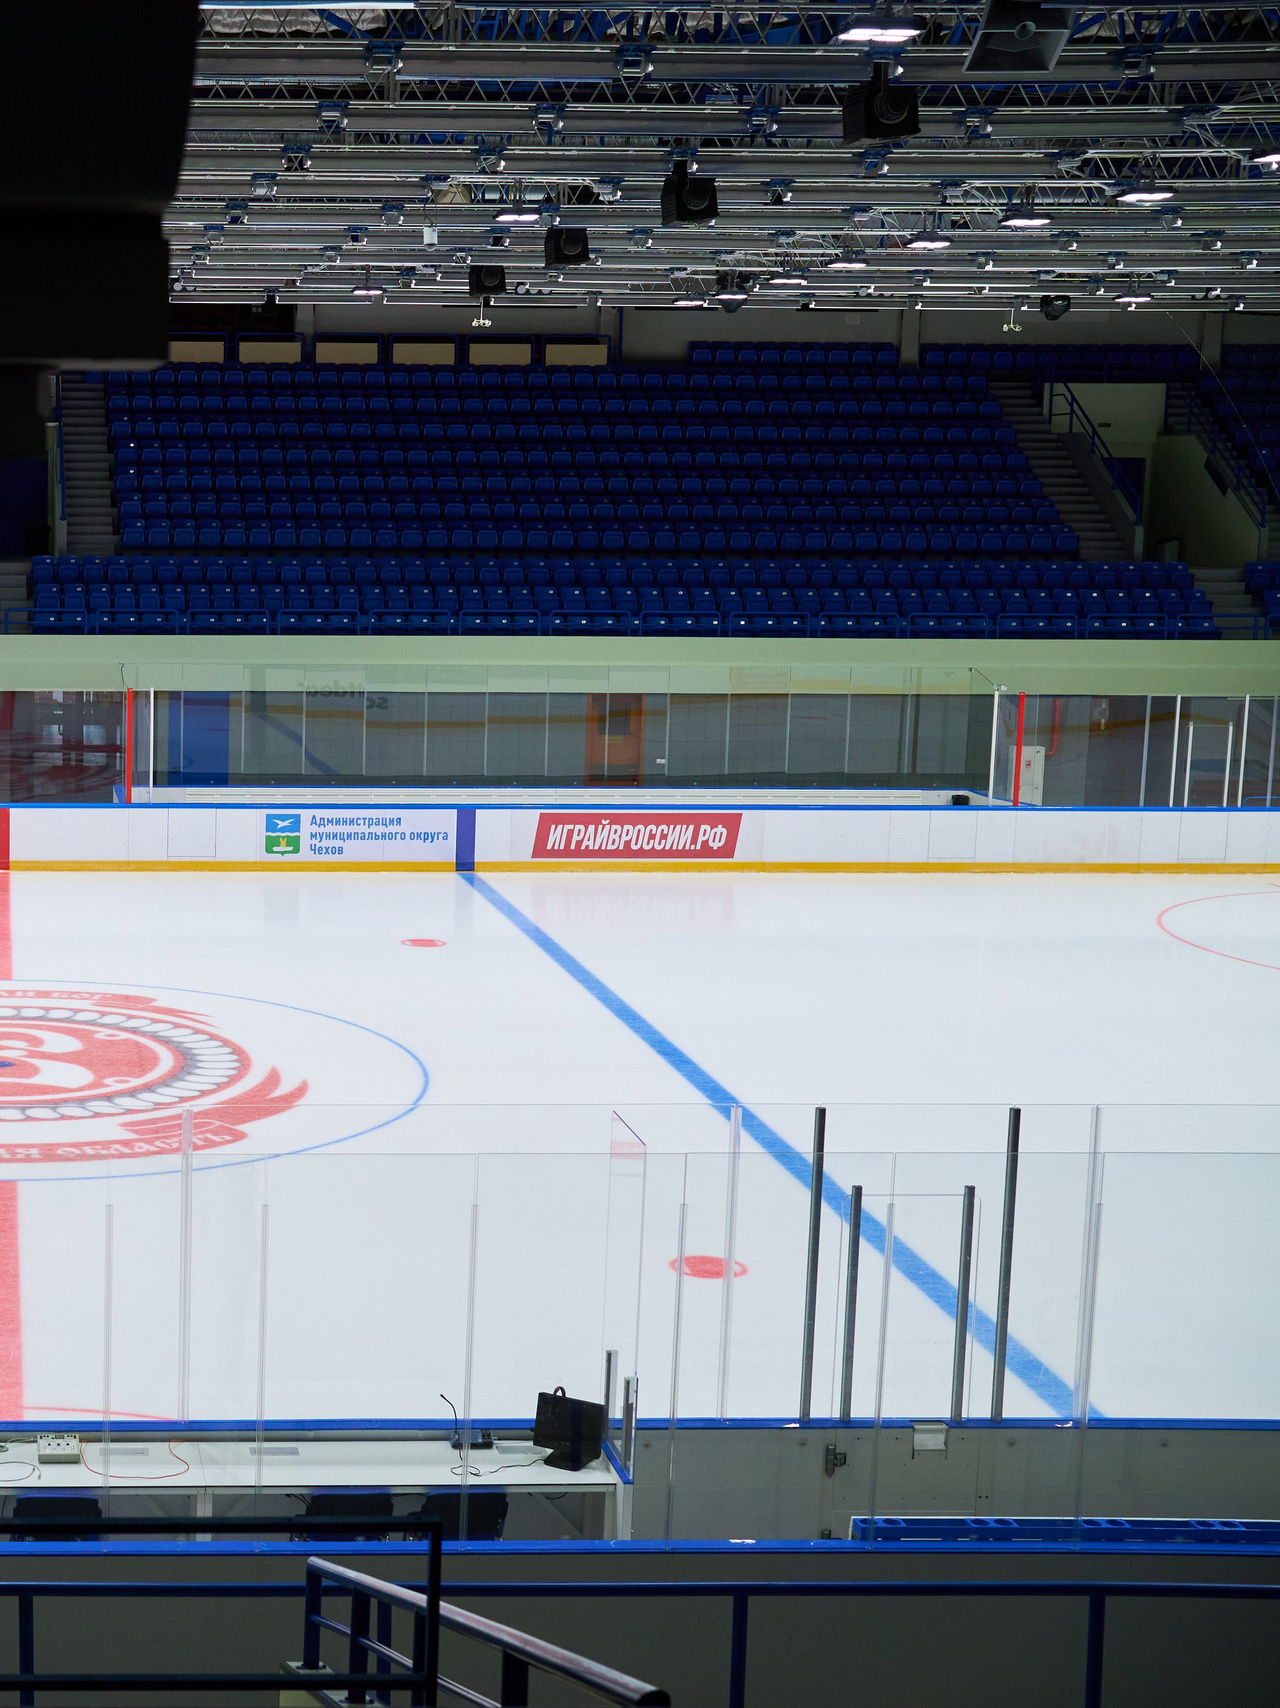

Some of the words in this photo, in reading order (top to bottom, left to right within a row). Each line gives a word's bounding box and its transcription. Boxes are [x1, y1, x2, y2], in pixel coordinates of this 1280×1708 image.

[310, 814, 402, 829] Администрация
[310, 830, 407, 843] муниципального
[409, 830, 449, 843] округа
[546, 819, 728, 850] ИГРАЙВРОССИИ.РФ
[310, 843, 344, 855] Чехов
[50, 991, 114, 1001] БОГ
[55, 1132, 234, 1158] ОБЛАСТЬ
